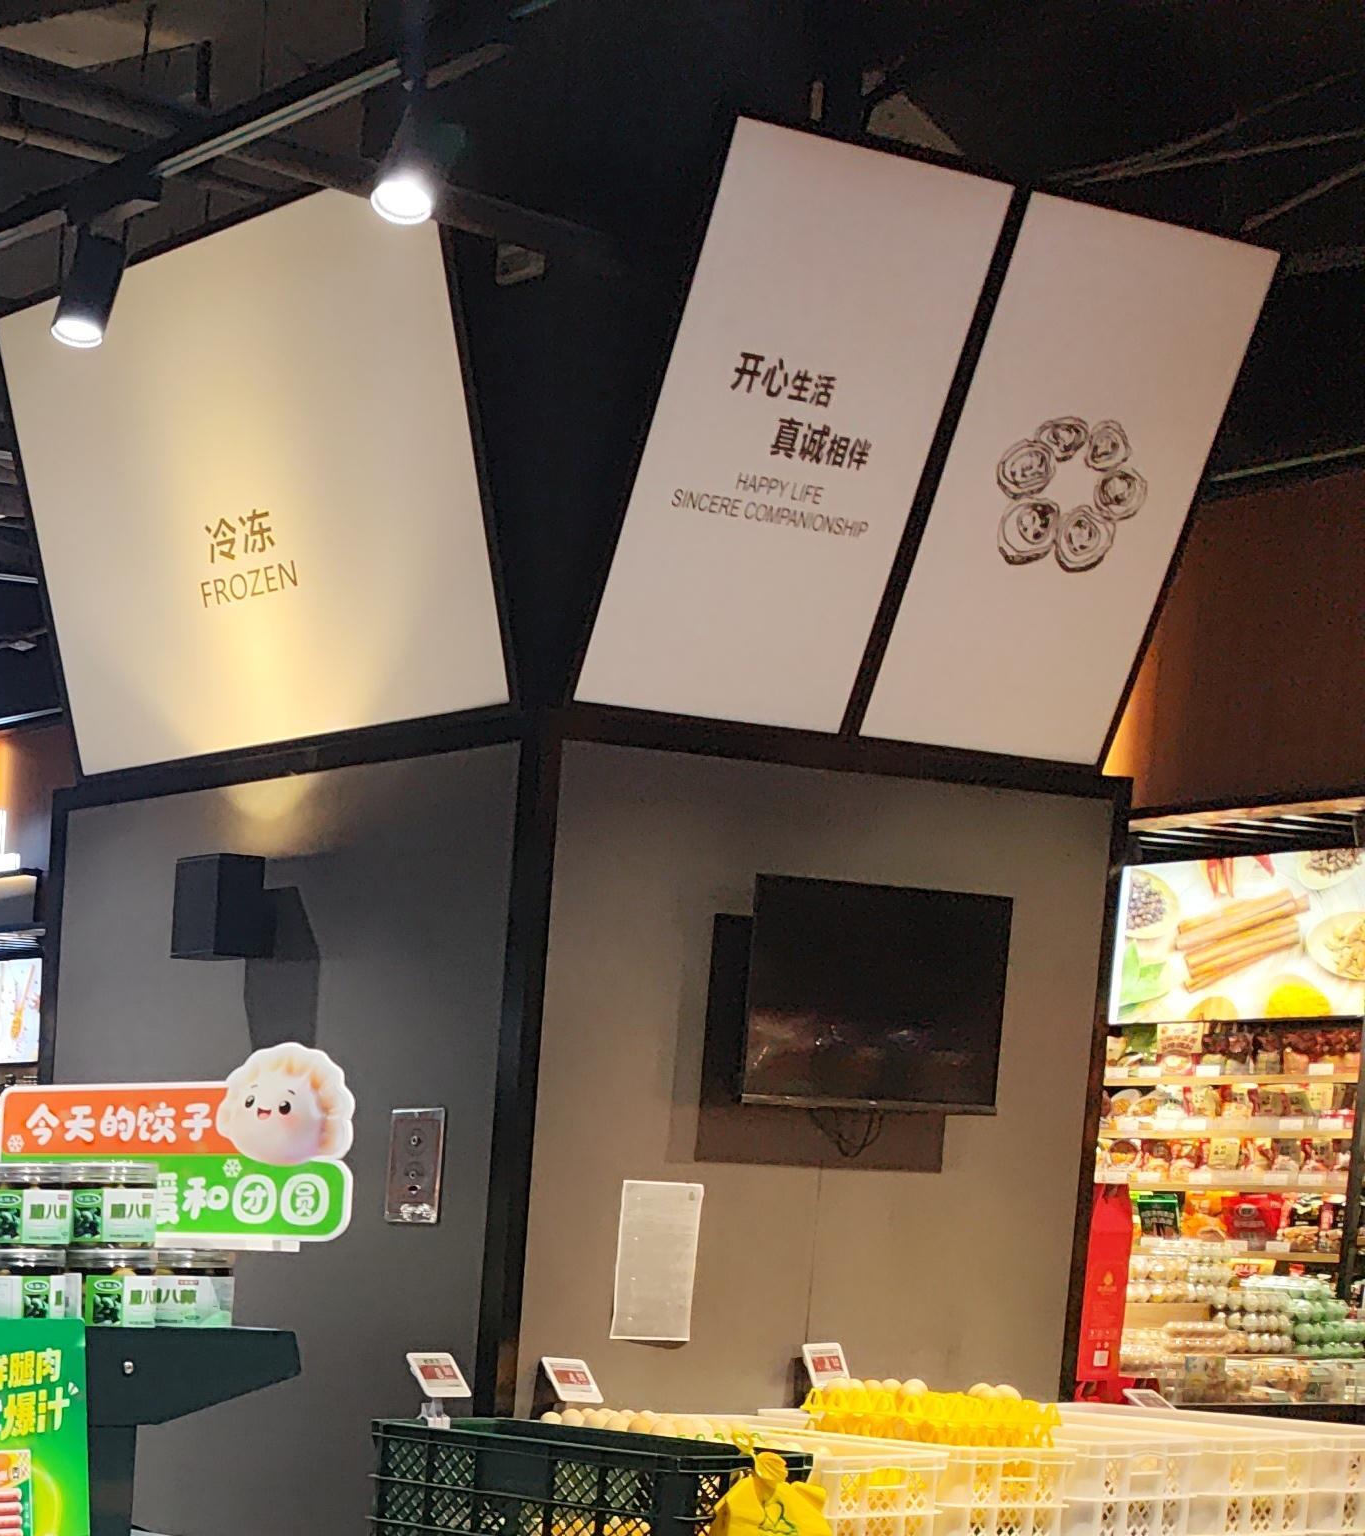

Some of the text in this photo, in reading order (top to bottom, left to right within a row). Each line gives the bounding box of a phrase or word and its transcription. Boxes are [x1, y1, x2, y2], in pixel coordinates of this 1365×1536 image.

[730, 351, 837, 408] 开心生活
[769, 417, 872, 471] 真诚相伴
[671, 488, 869, 538] SINCERE COMPANIONSHIP
[735, 472, 825, 505] HAPPY LIFE
[203, 508, 276, 564] 冷冻
[199, 559, 299, 608] FROZEN
[25, 1101, 214, 1146] 今天的饺子
